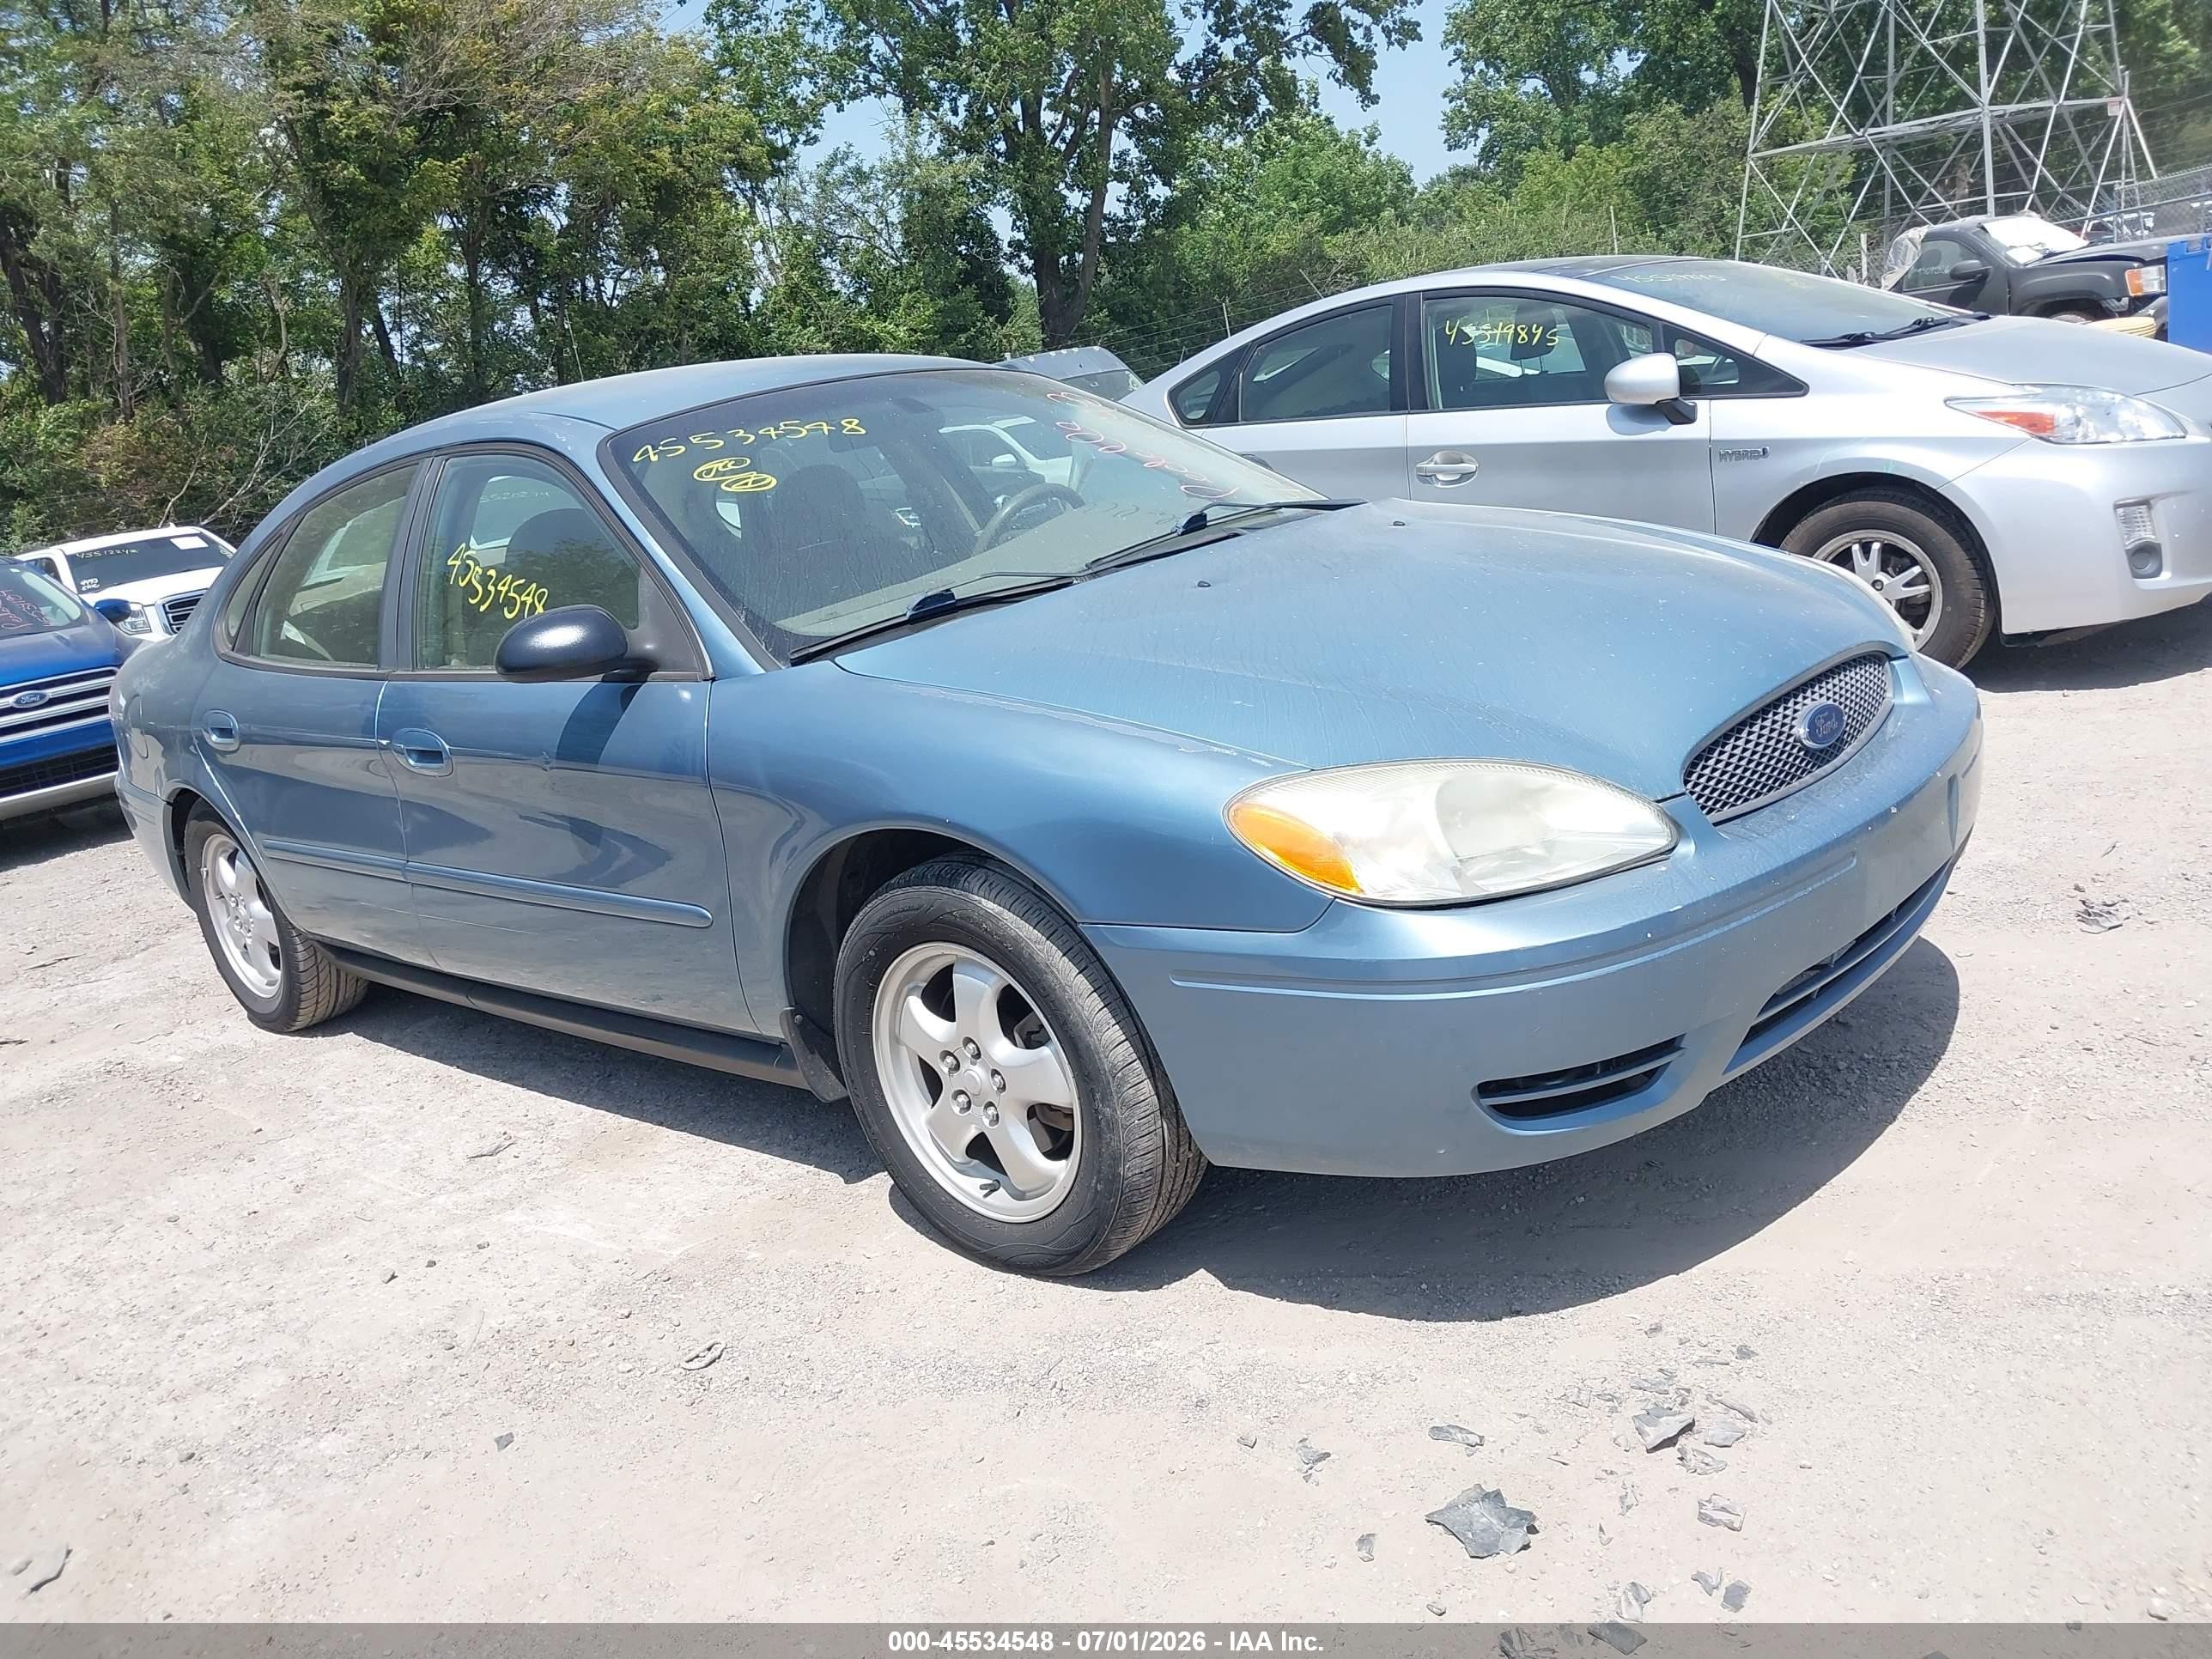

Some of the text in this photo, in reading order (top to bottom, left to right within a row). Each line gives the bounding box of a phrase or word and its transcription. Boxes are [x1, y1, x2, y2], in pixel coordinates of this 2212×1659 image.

[632, 417, 867, 464] 45534548
[1718, 448, 1763, 463] HYBRID
[447, 542, 550, 620] 45534548
[20, 693, 42, 704] Ford
[1814, 710, 1839, 738] Ford
